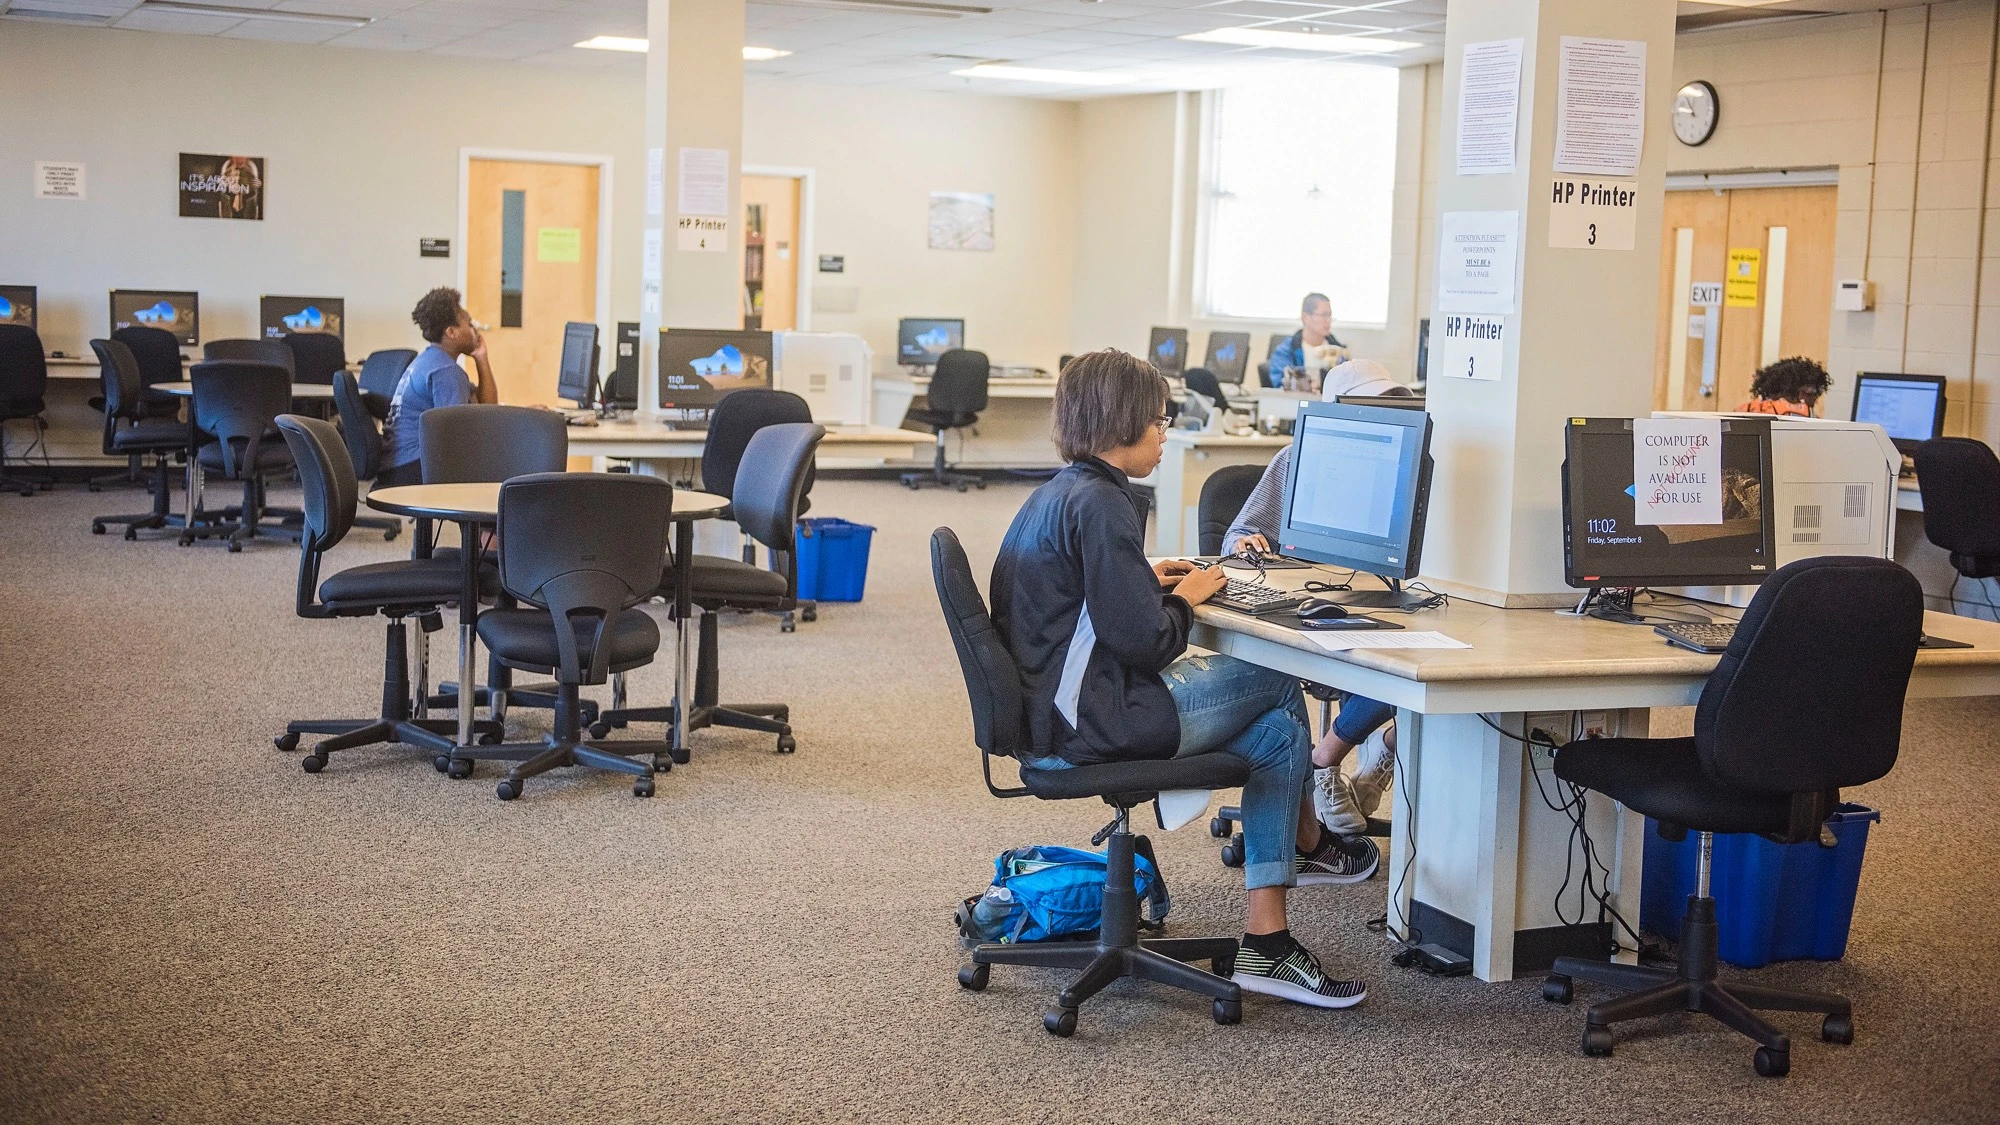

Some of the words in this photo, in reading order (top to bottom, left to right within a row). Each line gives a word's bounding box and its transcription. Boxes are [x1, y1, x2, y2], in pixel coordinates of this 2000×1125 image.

[189, 174, 205, 182] IT'S
[180, 180, 250, 195] INSPIRATION
[1552, 181, 1574, 204] HP
[1581, 183, 1635, 207] Printer
[679, 218, 691, 229] HP
[695, 218, 726, 230] Printer
[1588, 223, 1596, 245] 3
[699, 238, 705, 249] 4
[1462, 246, 1496, 254] POWERPOINTS
[1465, 270, 1472, 278] TO
[1692, 286, 1720, 302] EXIT
[1446, 316, 1461, 337] HP
[1464, 317, 1503, 340] Printer
[1468, 356, 1474, 377] 3
[1645, 435, 1709, 447] COMPUTER
[1659, 455, 1668, 466] IS
[1672, 455, 1697, 466] NOT
[1648, 472, 1707, 484] AVAILABLE
[1647, 483, 1668, 509] NOT
[1656, 492, 1679, 504] FOR
[1682, 492, 1702, 504] USE
[1587, 518, 1616, 533] 11:02
[1587, 536, 1606, 545] Friday,
[1607, 536, 1637, 545] September
